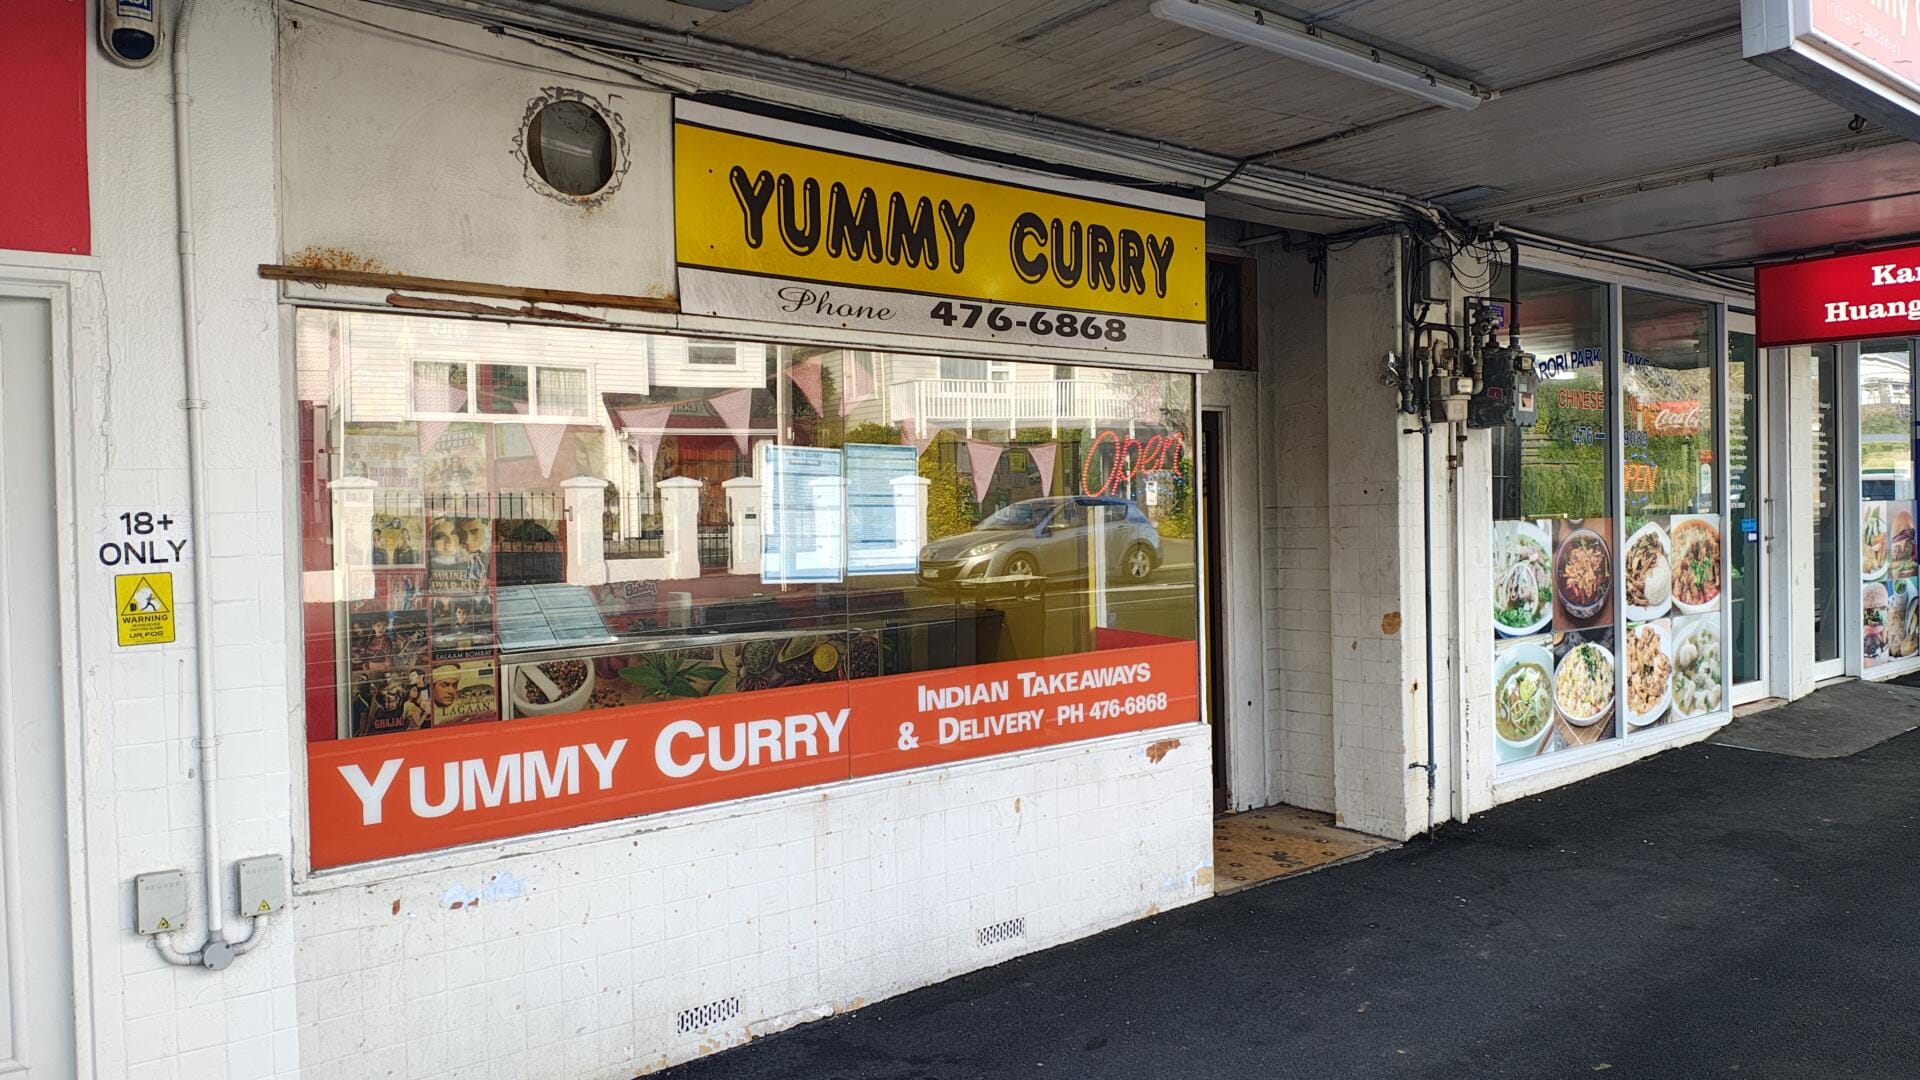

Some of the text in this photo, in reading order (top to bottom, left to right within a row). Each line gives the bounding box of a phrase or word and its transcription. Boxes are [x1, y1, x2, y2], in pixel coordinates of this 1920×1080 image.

[729, 164, 1175, 299] YUMMY CURRY
[777, 286, 1127, 342] Phone 476-6868
[1534, 355, 1568, 384] RORI
[1571, 348, 1601, 369] PARK
[1558, 388, 1605, 411] CHINESE
[1082, 431, 1185, 497] Open
[1623, 464, 1658, 492] PEN
[120, 511, 174, 536] 18+
[99, 539, 188, 566] ONLY
[122, 614, 169, 625] WARNING
[917, 662, 1152, 712] INDIAN TAKEAWAYS
[442, 702, 490, 717] LAGAAN
[897, 692, 1168, 751] & DELIVERY PH 476-6868
[337, 708, 851, 826] YUMMY CURRY
